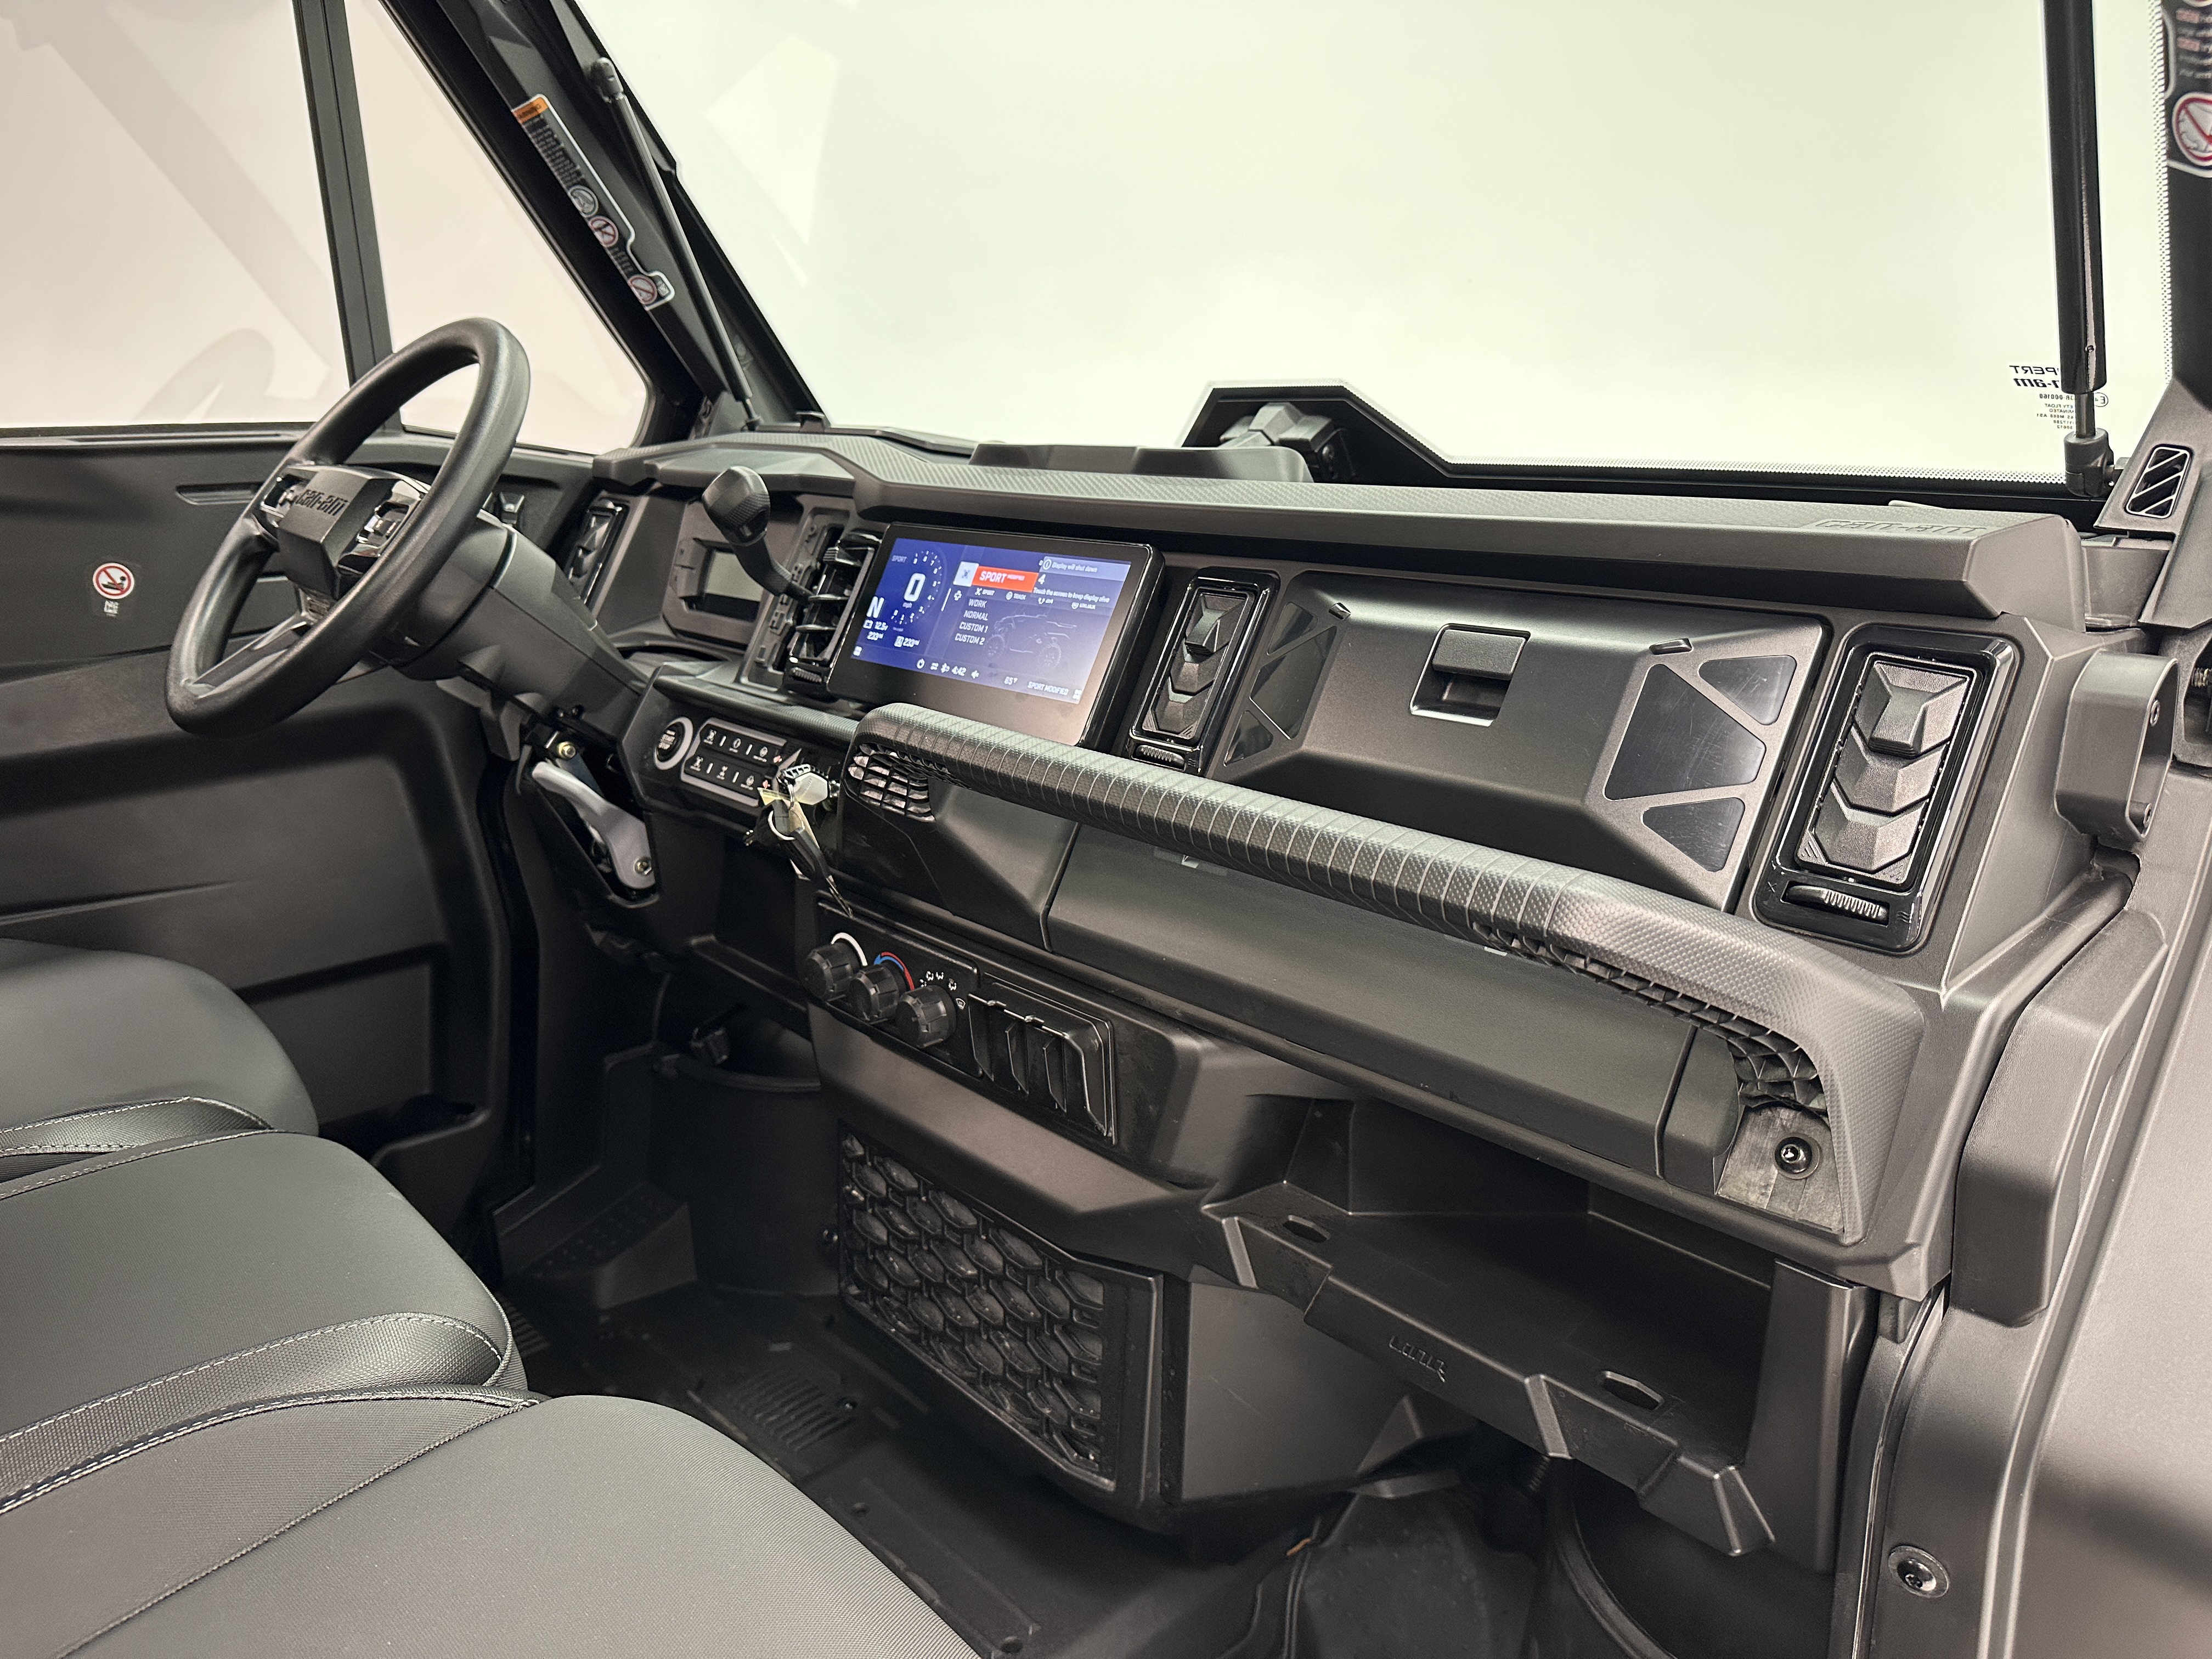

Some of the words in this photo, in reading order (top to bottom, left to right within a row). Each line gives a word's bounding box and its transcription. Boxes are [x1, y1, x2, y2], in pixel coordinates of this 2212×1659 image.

[979, 570, 1008, 584] SPORT
[1038, 574, 1046, 585] 4
[903, 572, 926, 602] 0
[866, 596, 885, 618] N
[968, 599, 988, 608] WORK
[963, 610, 989, 621] NORMAL
[959, 622, 984, 633] CUSTOM
[955, 633, 979, 645] CUSTOM
[979, 637, 985, 645] 2
[1028, 681, 1045, 691] SPORT
[1044, 684, 1069, 696] MODIFIED
